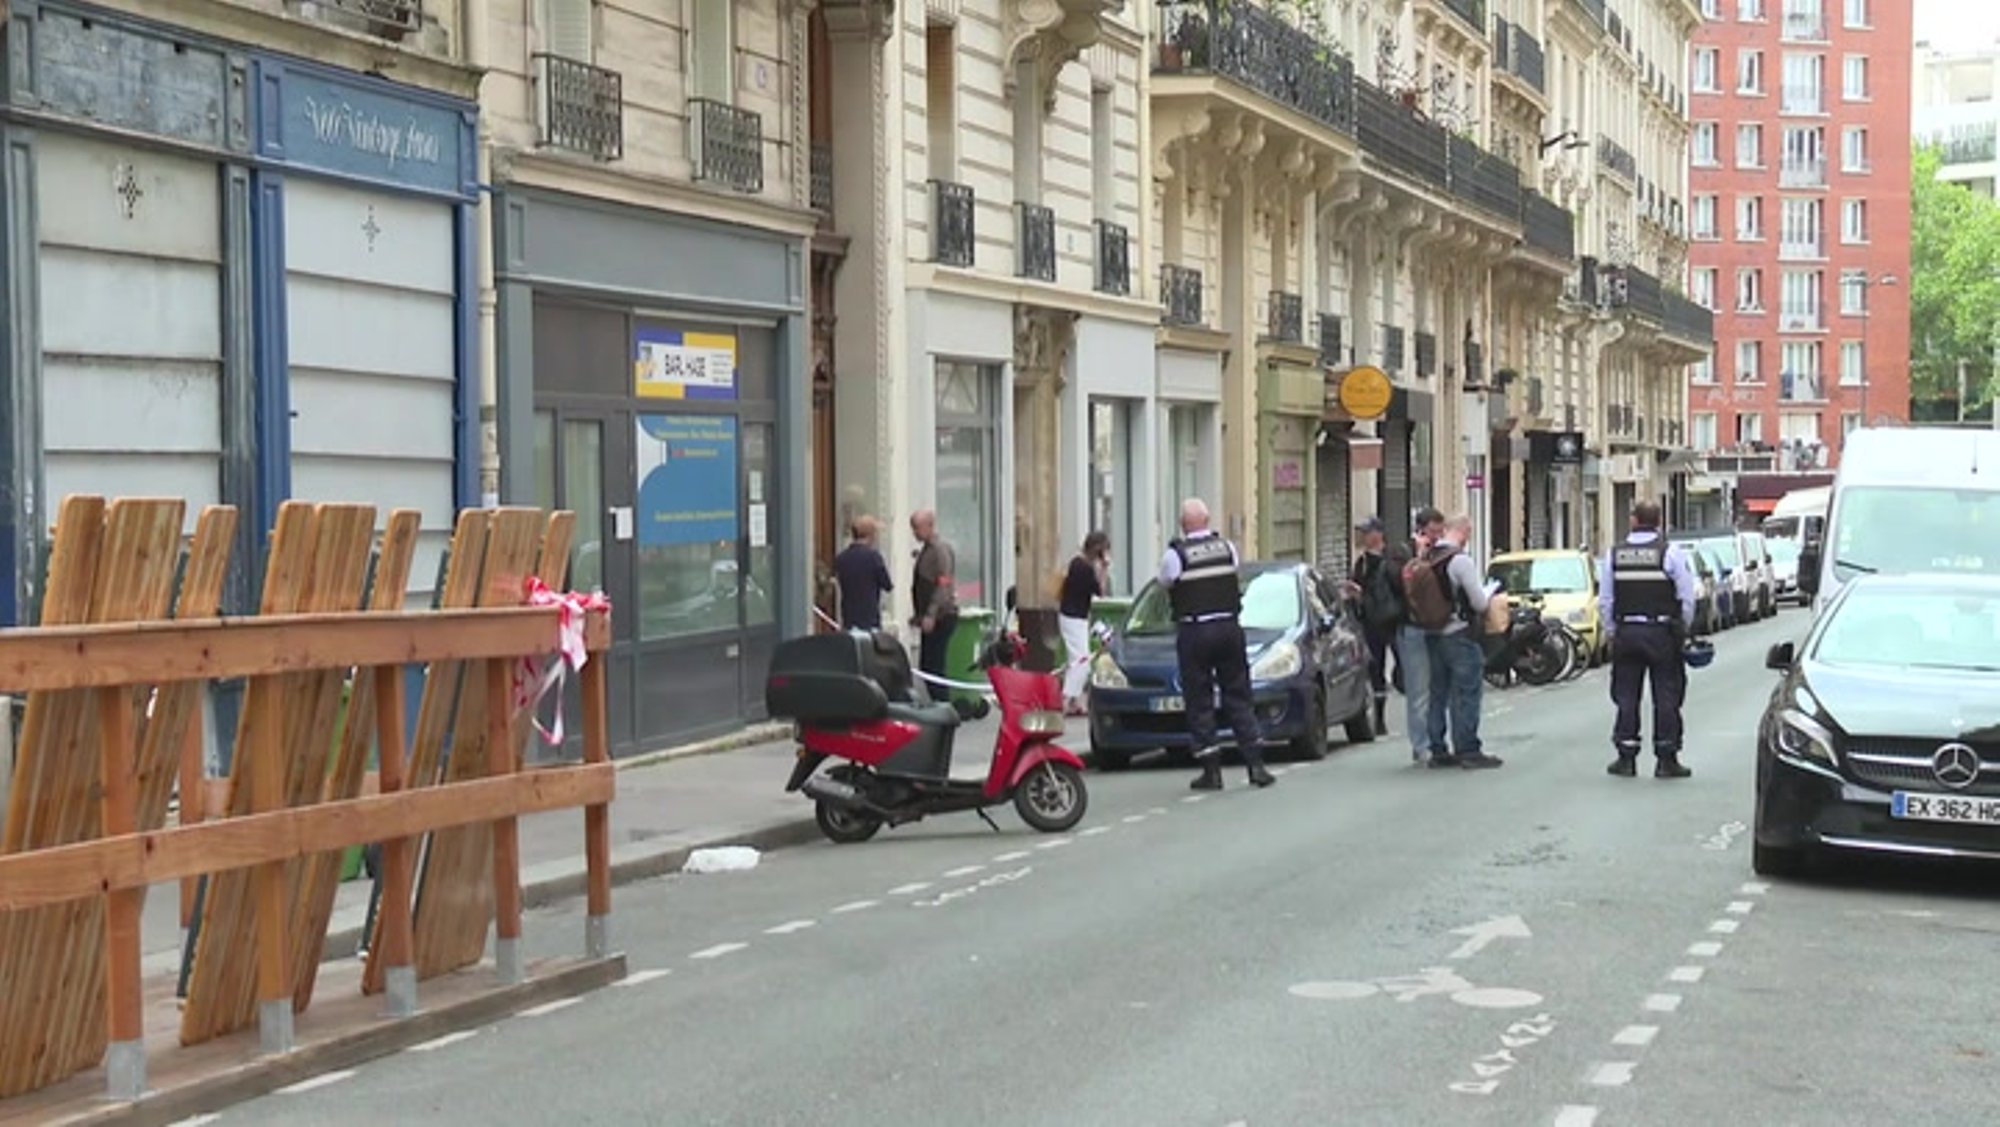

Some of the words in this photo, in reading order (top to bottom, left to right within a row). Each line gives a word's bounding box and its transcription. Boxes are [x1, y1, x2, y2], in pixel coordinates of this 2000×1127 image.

[1187, 541, 1228, 560] POLICE
[1618, 548, 1658, 565] POLICE
[1906, 796, 1930, 817] EX
[1937, 799, 1972, 819] 362
